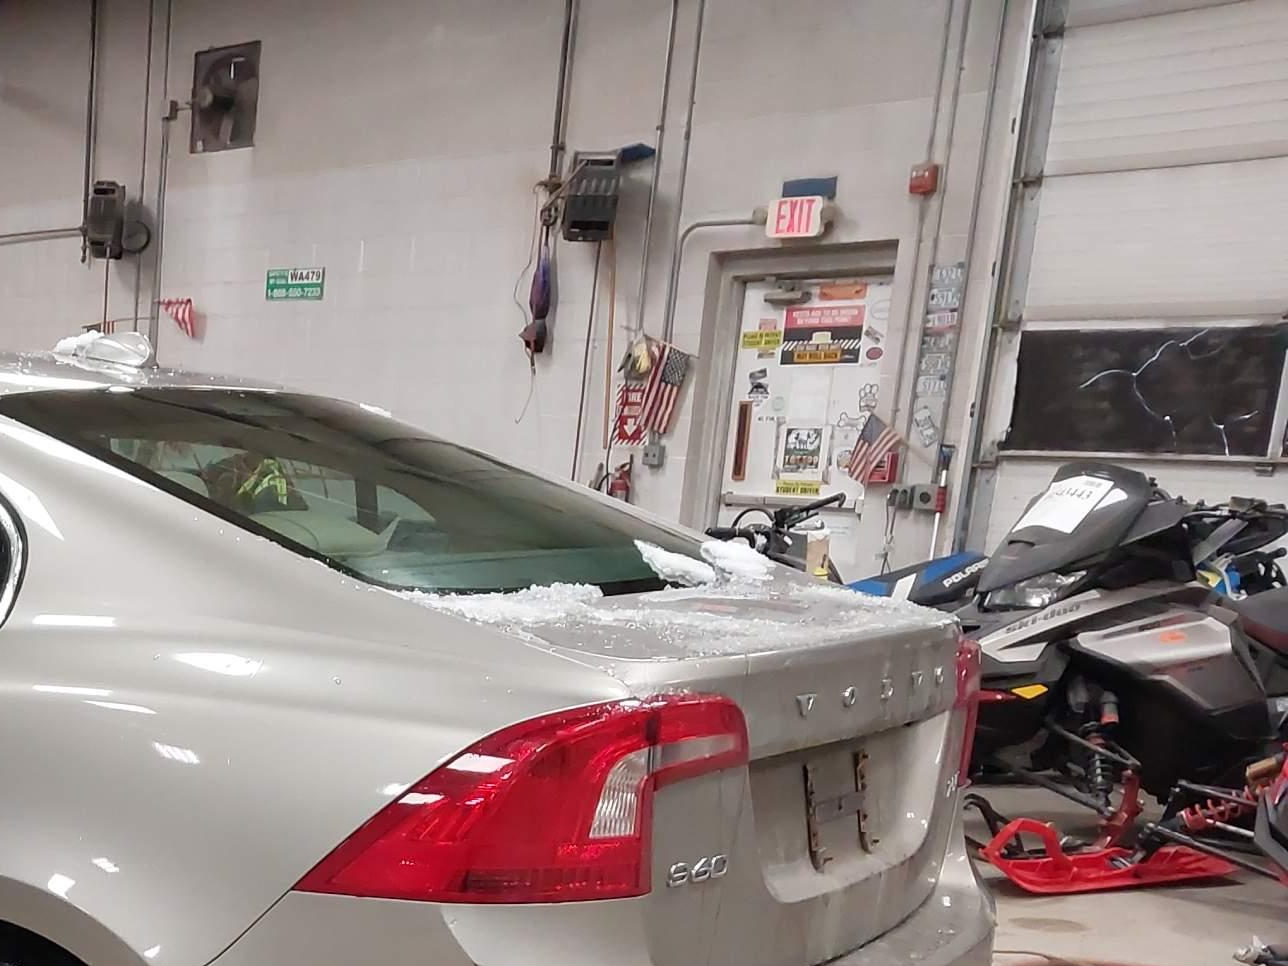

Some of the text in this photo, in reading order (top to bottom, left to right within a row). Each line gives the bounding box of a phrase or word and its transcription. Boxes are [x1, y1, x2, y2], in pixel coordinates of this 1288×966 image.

[775, 199, 816, 234] EXIT
[290, 270, 321, 283] WA479
[667, 855, 728, 888] S60
